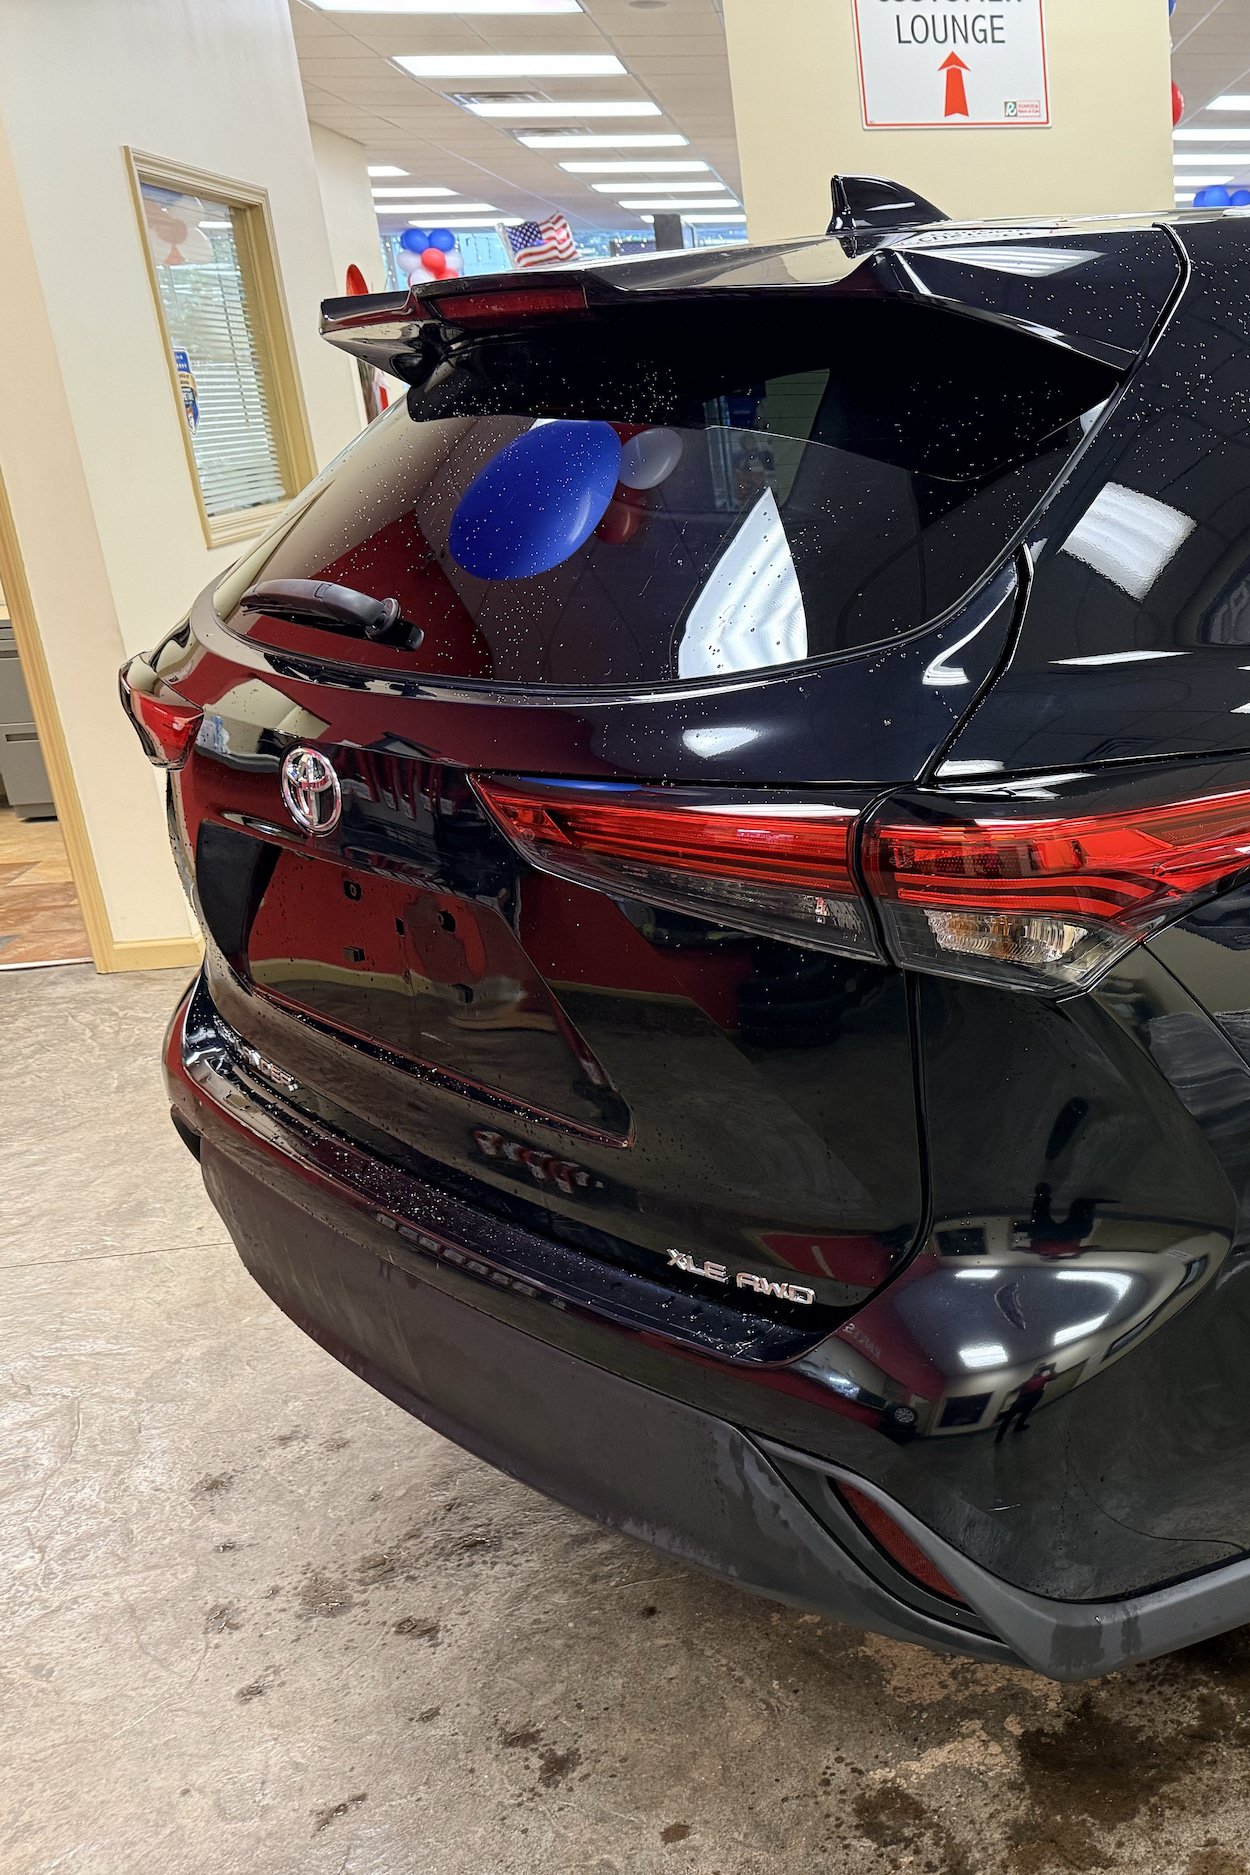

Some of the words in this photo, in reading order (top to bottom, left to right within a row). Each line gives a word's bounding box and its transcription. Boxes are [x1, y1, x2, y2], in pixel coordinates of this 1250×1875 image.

[896, 14, 1006, 44] LOUNGE
[667, 1248, 729, 1284] XLE
[736, 1272, 816, 1305] AWD
